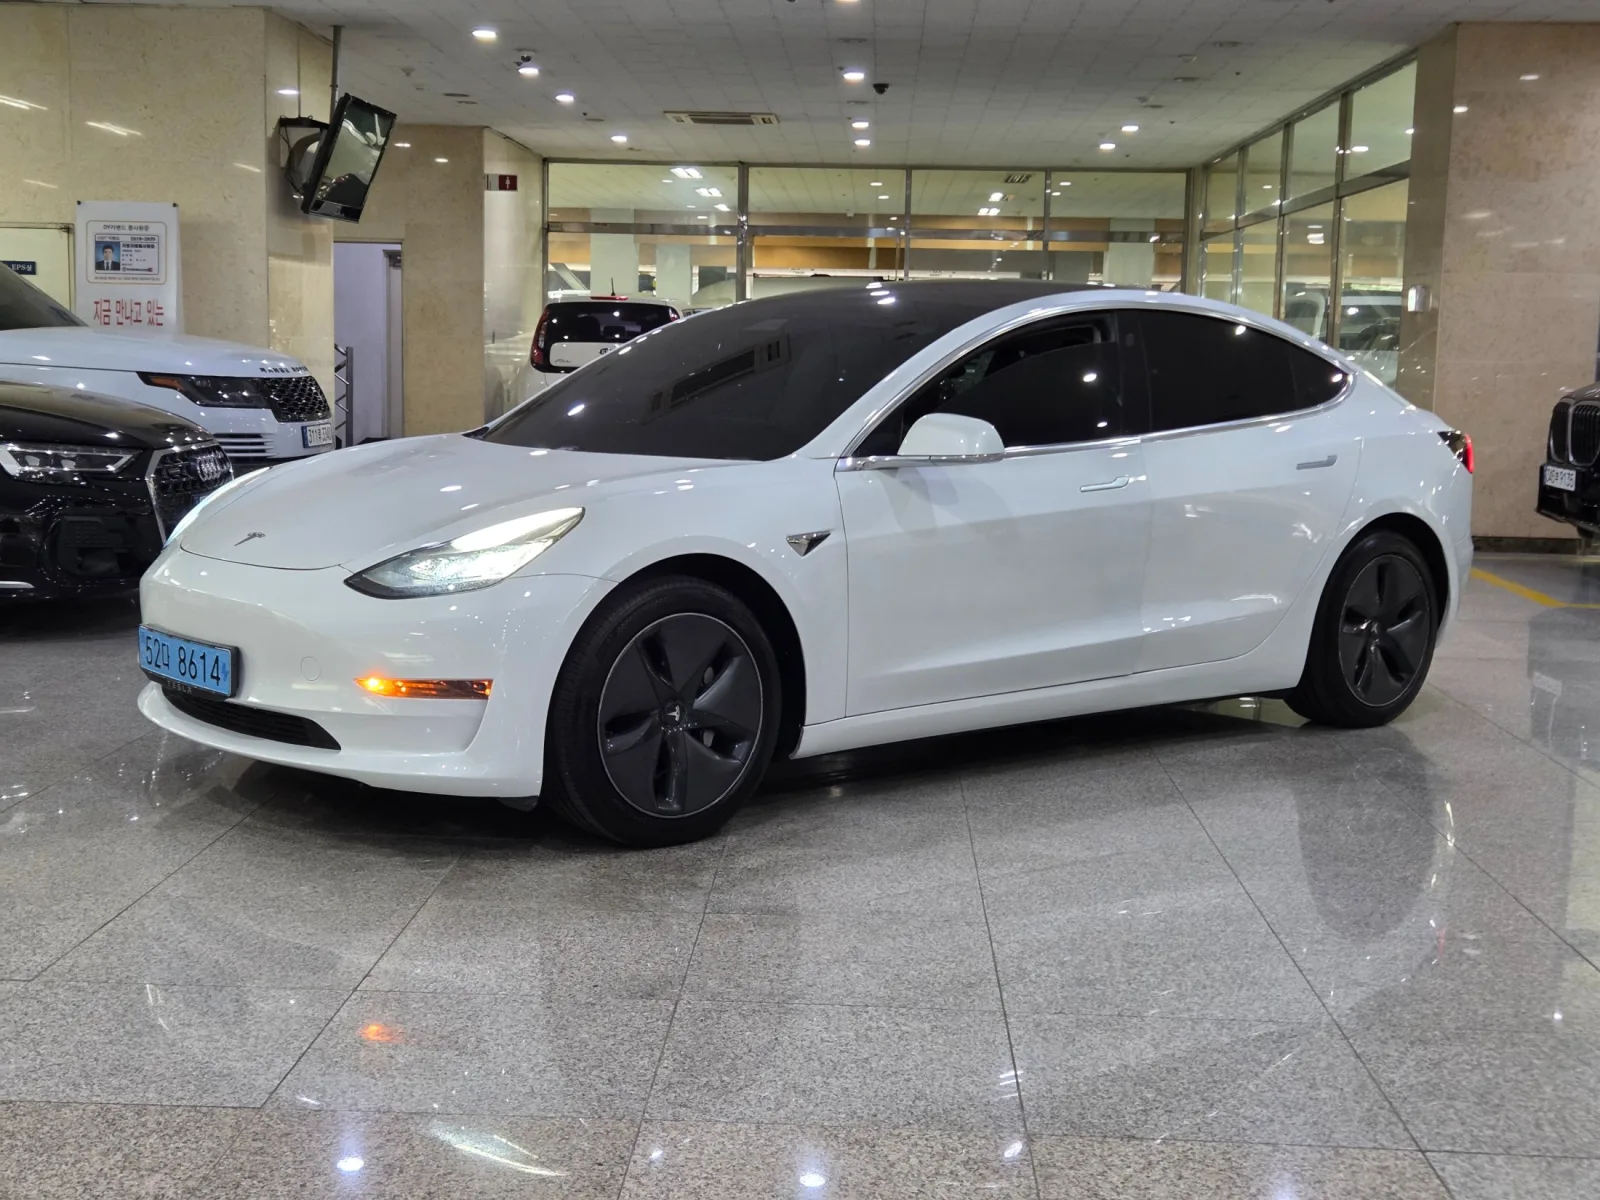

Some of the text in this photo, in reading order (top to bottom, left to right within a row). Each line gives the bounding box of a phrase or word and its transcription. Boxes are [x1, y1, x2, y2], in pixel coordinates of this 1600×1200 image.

[93, 298, 164, 326] 지금 만나고 있는
[145, 635, 221, 687] 52마 8614
[167, 680, 194, 695] TESLA
